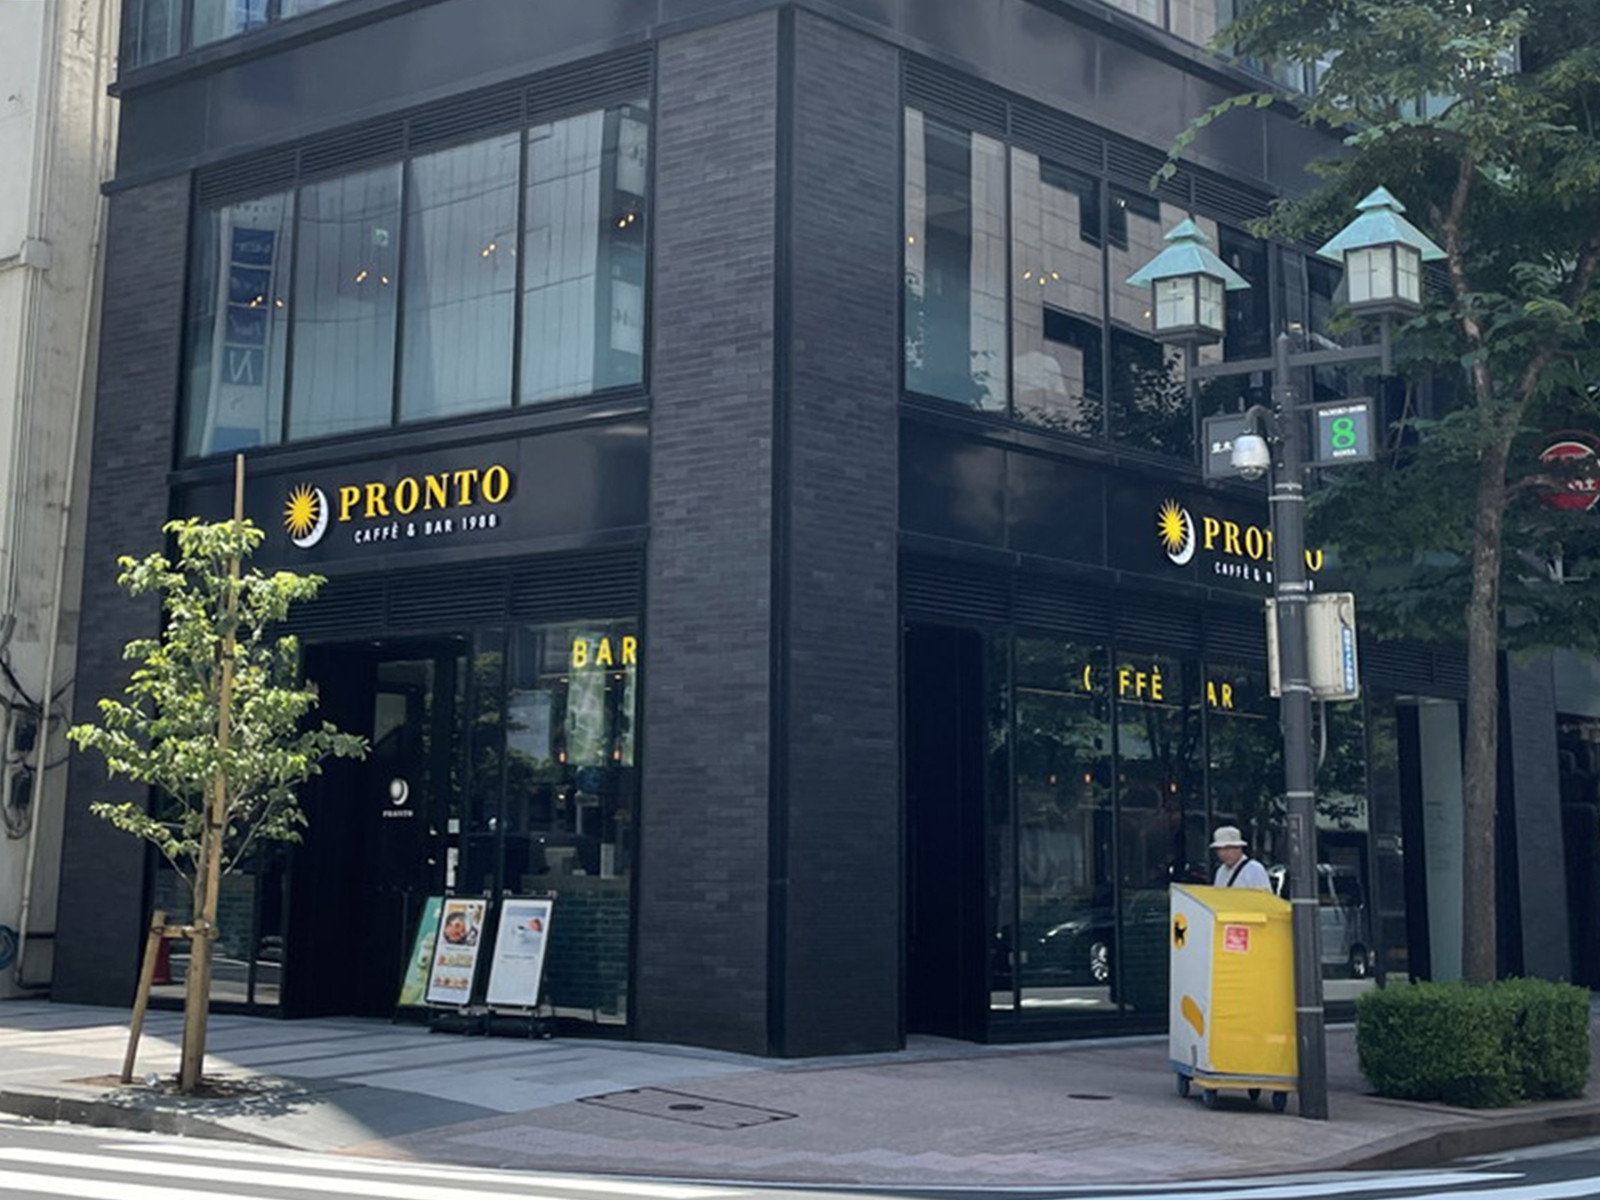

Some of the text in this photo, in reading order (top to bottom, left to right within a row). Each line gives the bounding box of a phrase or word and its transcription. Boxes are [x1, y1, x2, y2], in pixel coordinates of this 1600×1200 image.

[1331, 417, 1356, 449] 8
[339, 465, 510, 521] PRONTO
[354, 521, 398, 543] CAFFÈ
[407, 523, 415, 537] &
[425, 518, 452, 535] BAR
[573, 635, 637, 668] BAR
